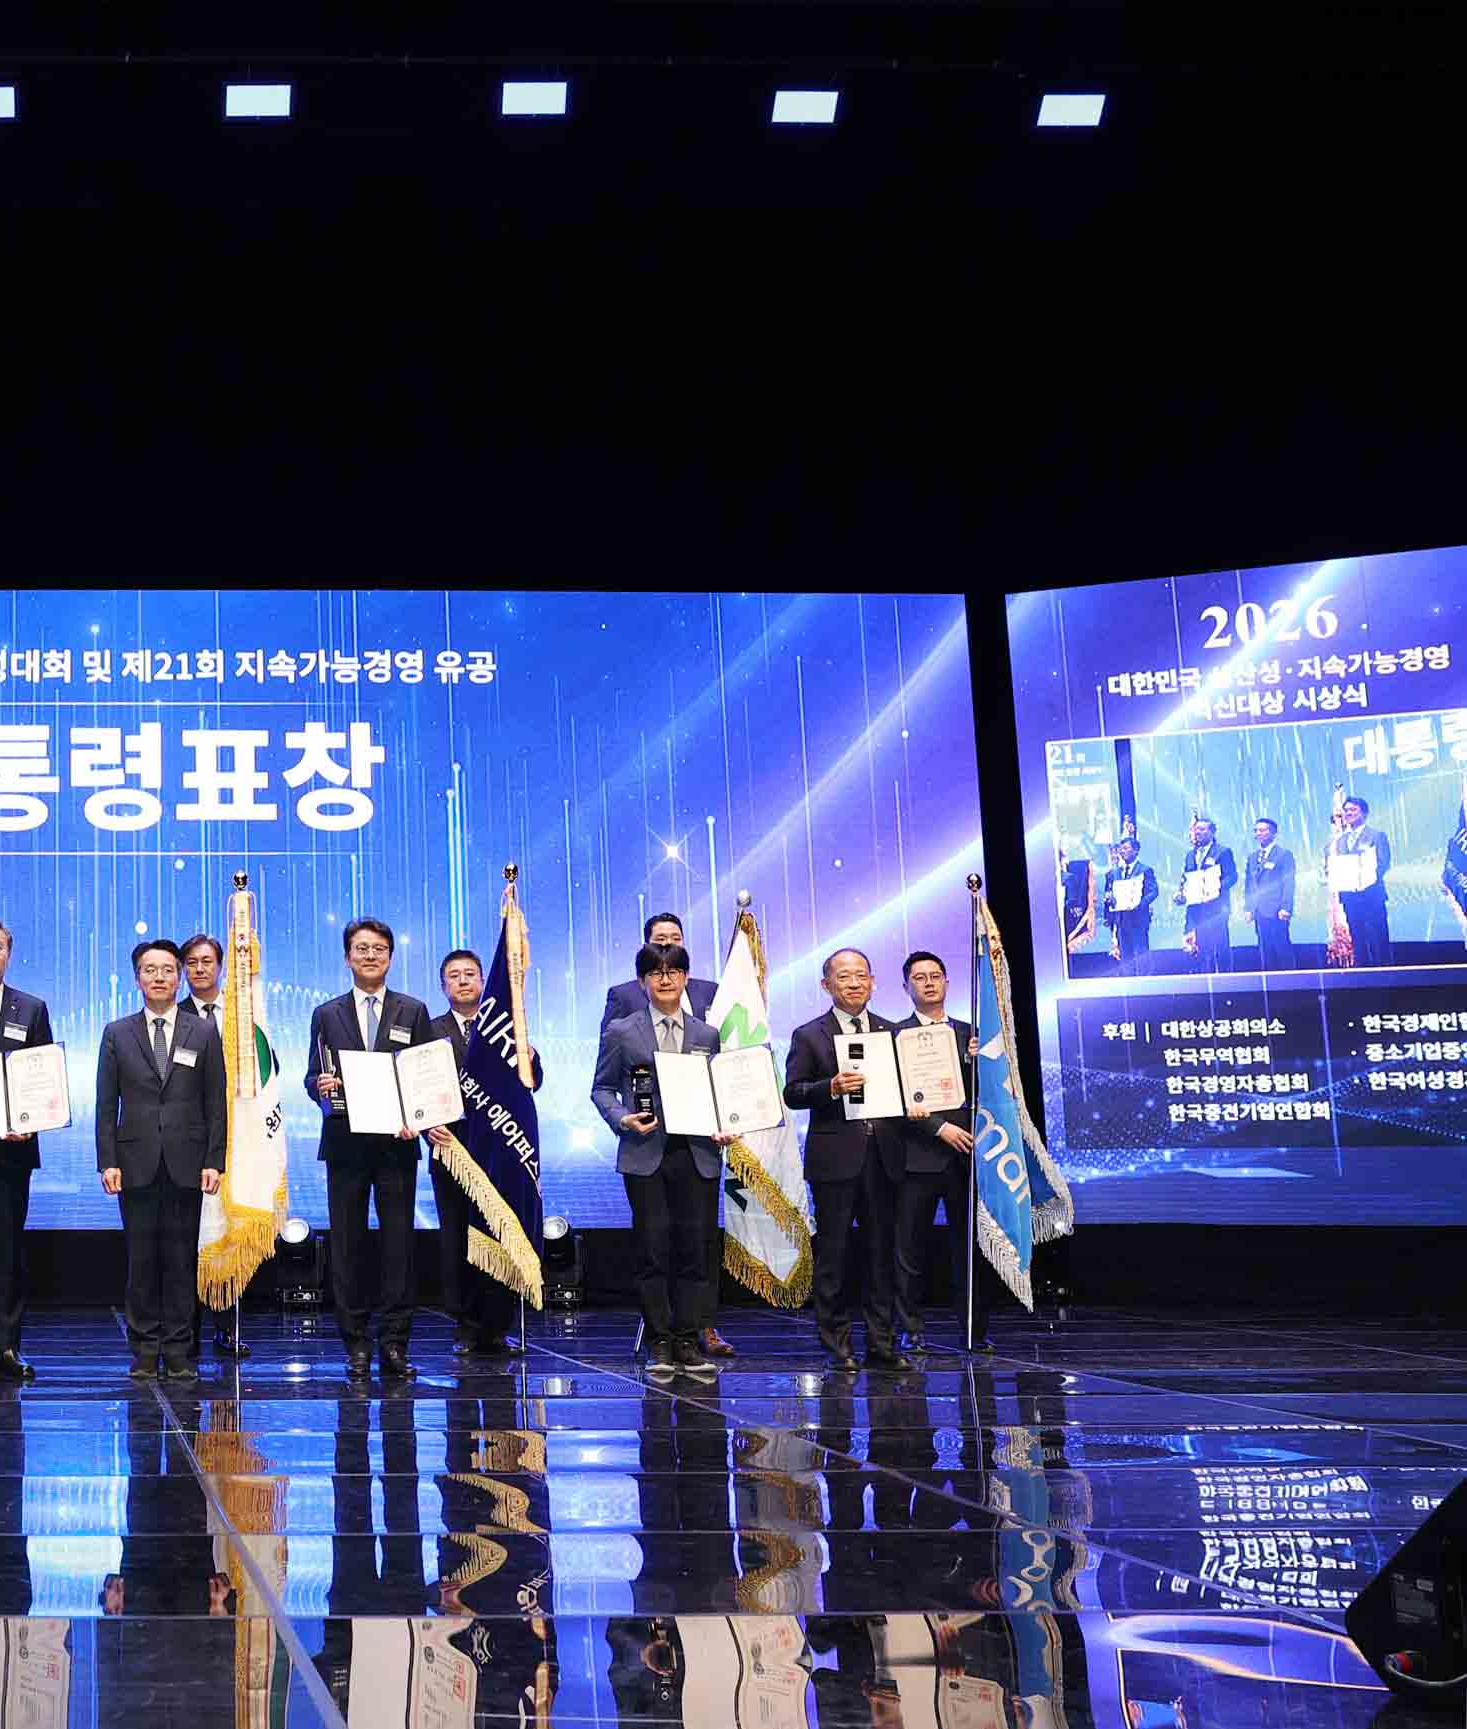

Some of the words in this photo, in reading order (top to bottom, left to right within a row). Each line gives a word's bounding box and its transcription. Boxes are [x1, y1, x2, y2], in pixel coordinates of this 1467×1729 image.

[1200, 594, 1339, 649] 2026
[82, 649, 112, 684] 및
[121, 649, 225, 684] 제21회
[234, 649, 426, 685] 지속가능경영
[434, 649, 497, 685] 유공
[1107, 666, 1202, 697] 대한민국
[1293, 682, 1369, 712] 시상식
[1102, 1022, 1137, 1041] 후원
[1161, 1018, 1287, 1040] 대한상공회의소
[1163, 1045, 1271, 1067] 한국무역협회
[1166, 1073, 1310, 1095] 한국경영자총협회
[1366, 1070, 1467, 1091] 한국여성경
